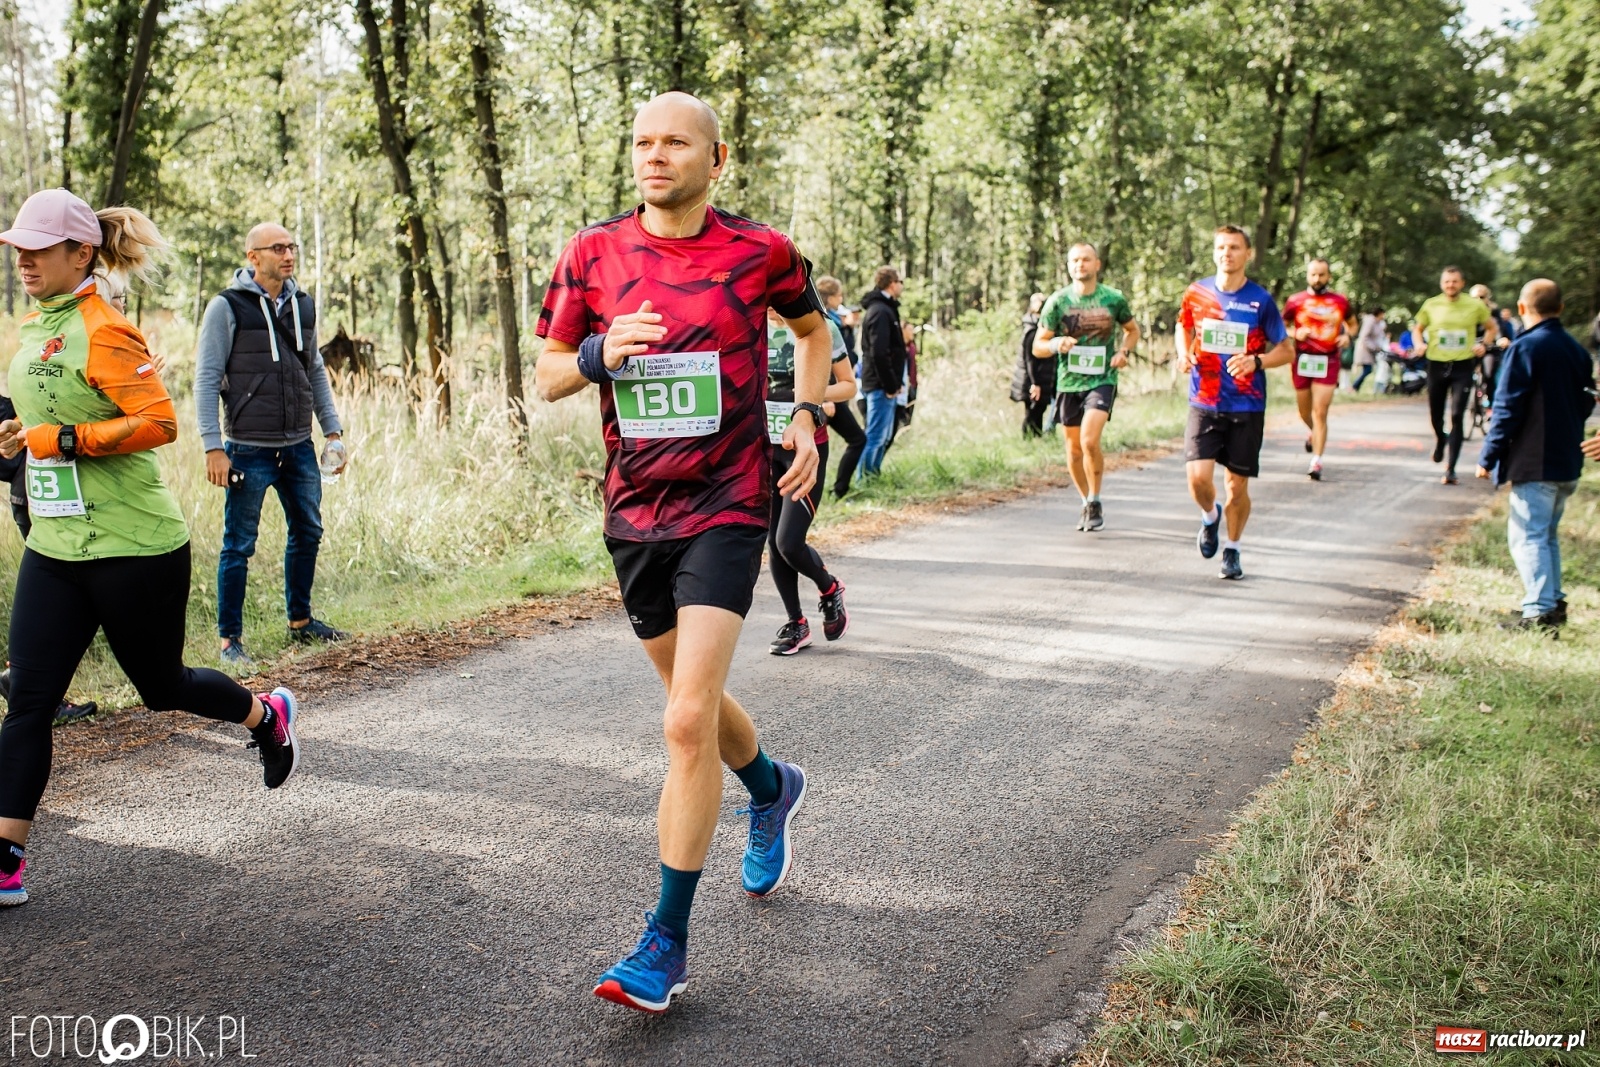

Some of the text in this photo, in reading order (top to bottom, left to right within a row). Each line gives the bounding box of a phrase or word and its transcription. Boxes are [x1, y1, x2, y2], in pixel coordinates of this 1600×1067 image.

[710, 271, 732, 283] 4F
[1210, 331, 1237, 347] 159
[636, 358, 646, 377] V
[1078, 356, 1096, 367] 67
[28, 366, 63, 378] DZIKI
[631, 380, 697, 417] 130
